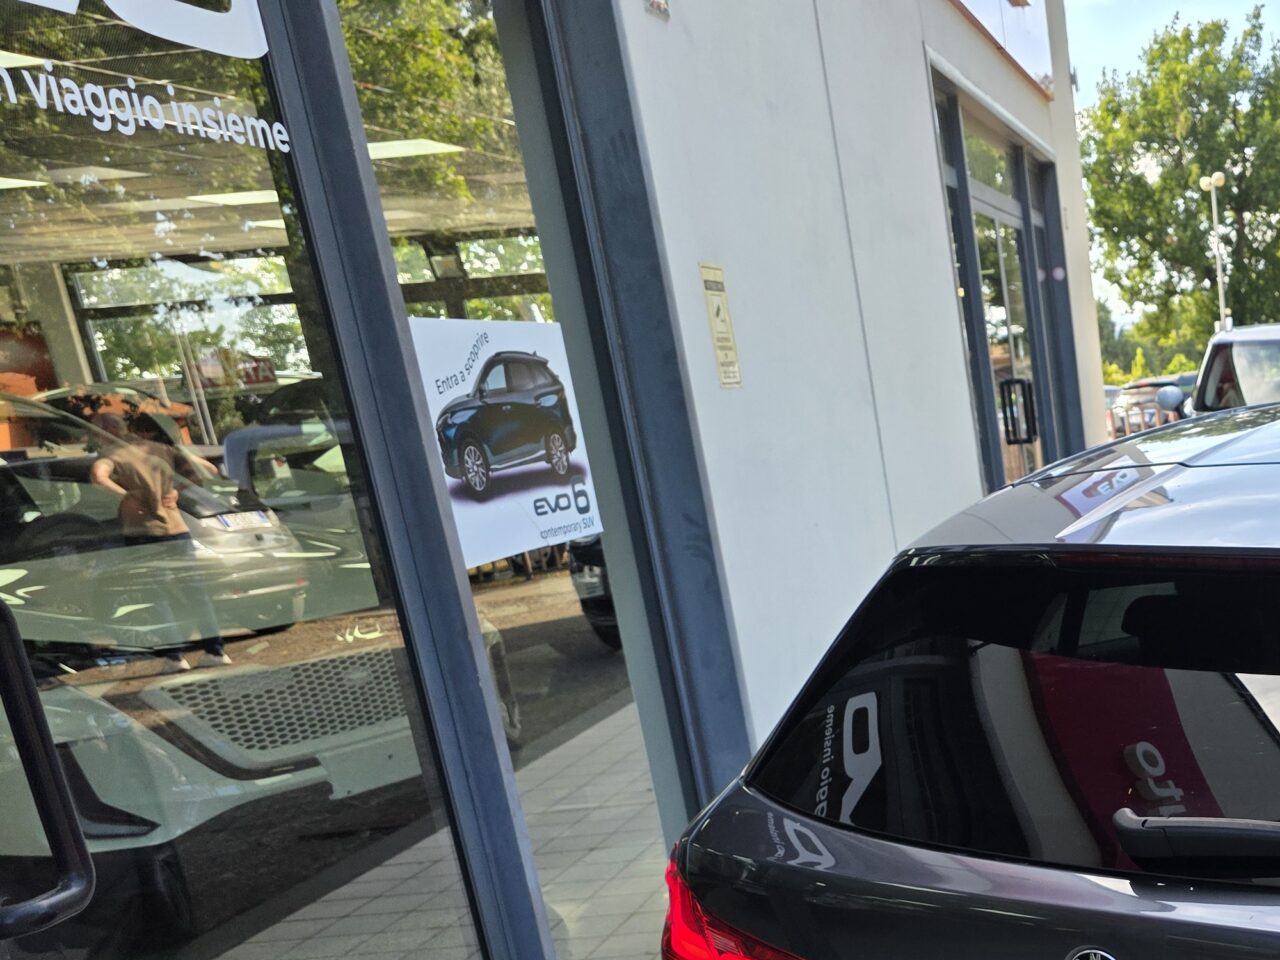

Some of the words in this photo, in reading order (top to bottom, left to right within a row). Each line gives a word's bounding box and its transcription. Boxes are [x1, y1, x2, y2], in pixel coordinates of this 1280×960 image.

[21, 60, 165, 136] viaggio
[166, 84, 291, 153] insieme
[435, 370, 459, 395] Entra
[460, 372, 466, 383] a
[465, 331, 489, 374] scoprire
[533, 493, 571, 516] EVO
[540, 520, 582, 539] contemporary
[583, 516, 595, 530] SUV
